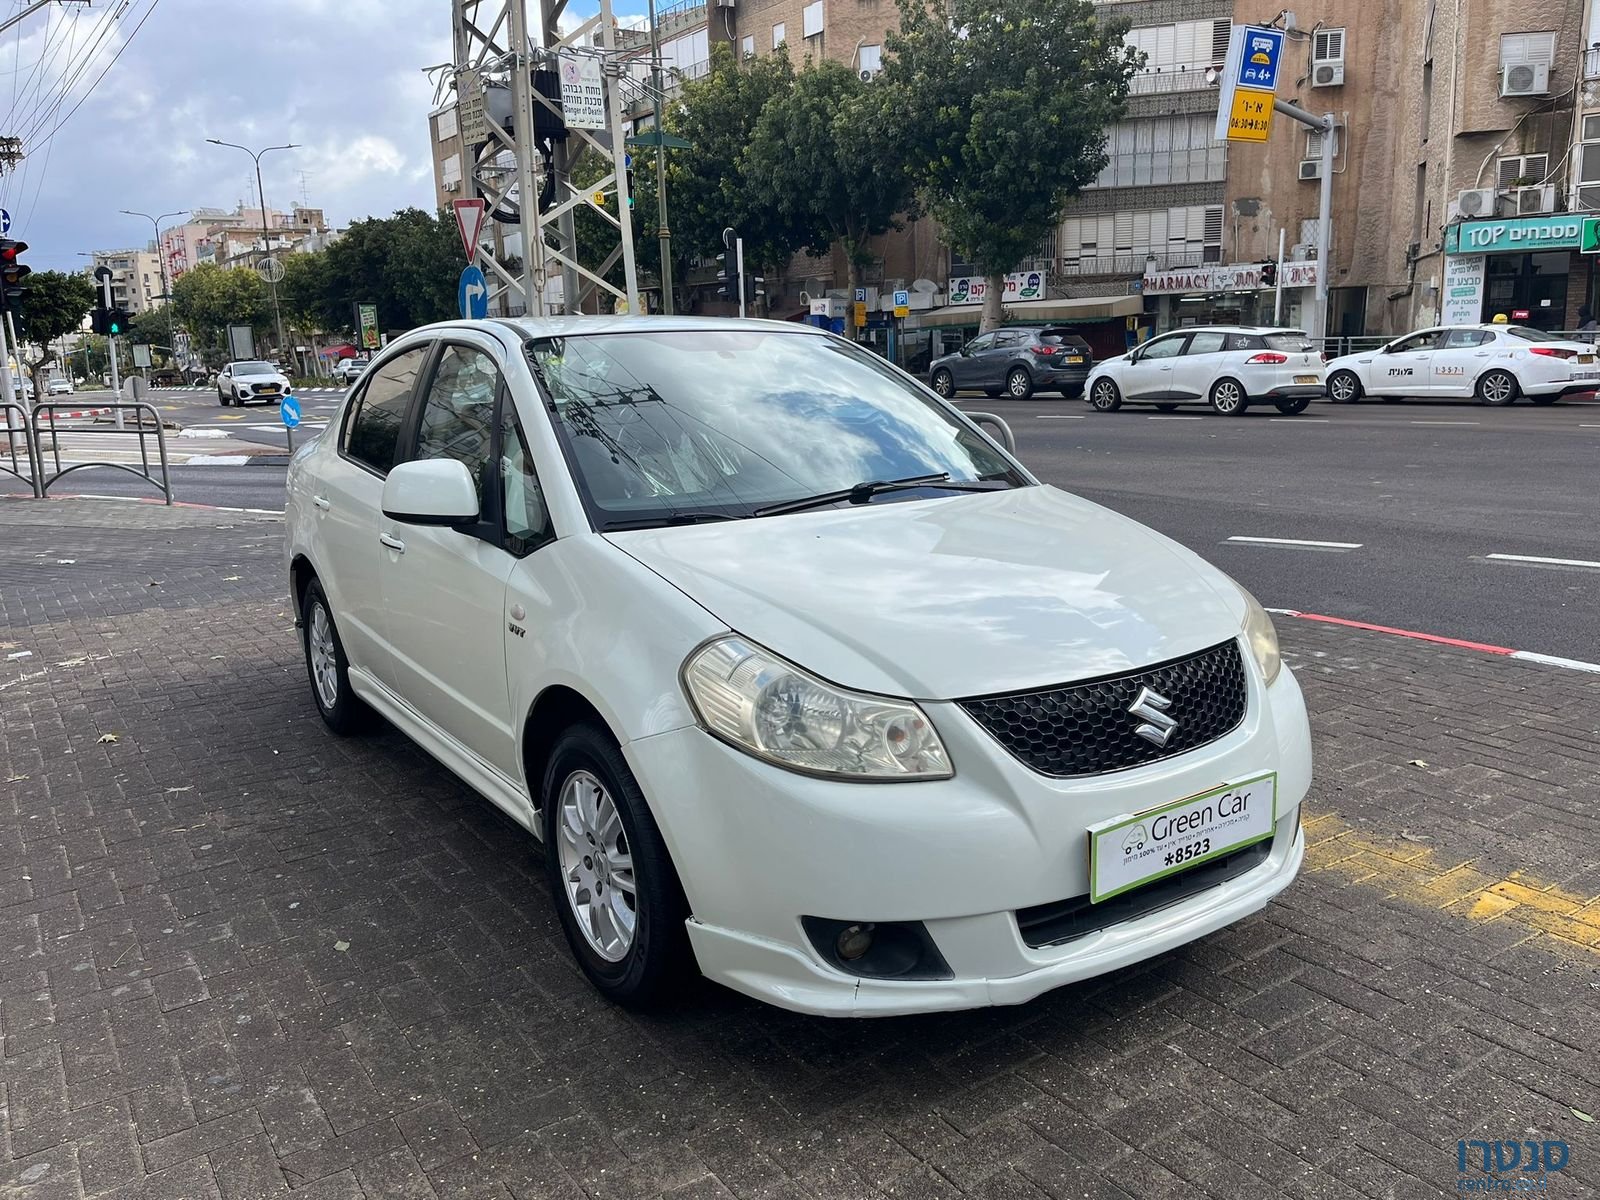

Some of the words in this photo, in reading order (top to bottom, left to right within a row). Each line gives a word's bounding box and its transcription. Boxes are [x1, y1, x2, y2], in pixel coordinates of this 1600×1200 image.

[1467, 225, 1506, 247] TOP
[1142, 274, 1210, 291] PHARMACY
[1152, 805, 1212, 841] Green
[1218, 792, 1251, 818] Car
[1138, 847, 1155, 858] 100%
